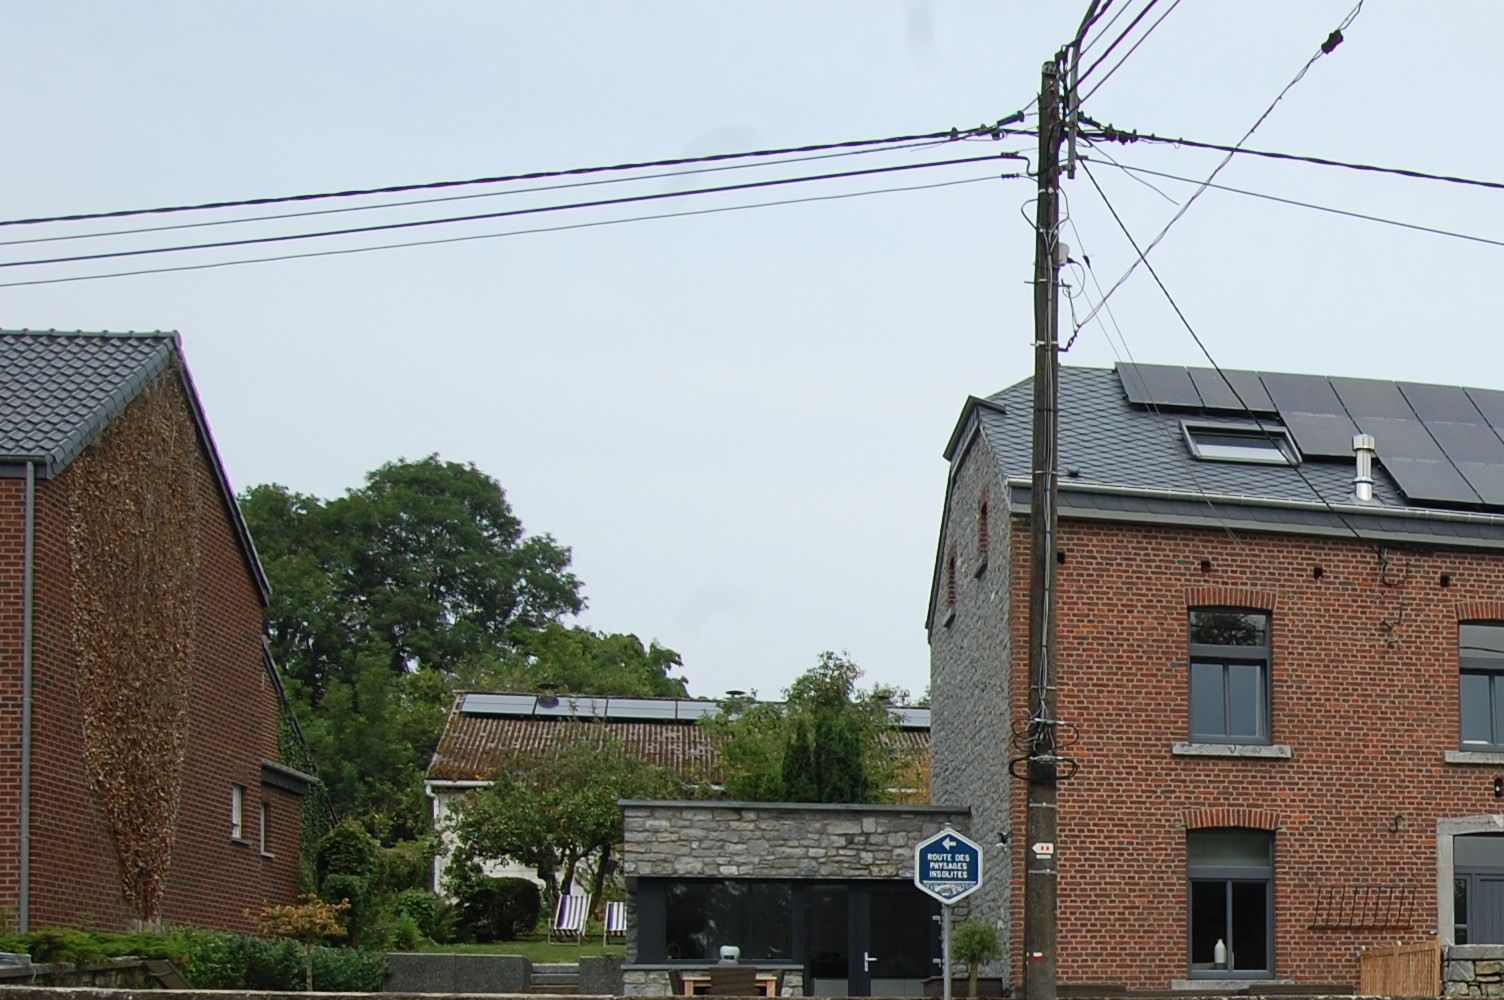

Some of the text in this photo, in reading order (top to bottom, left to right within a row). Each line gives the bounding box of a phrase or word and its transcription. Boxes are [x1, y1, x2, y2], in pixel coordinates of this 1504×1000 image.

[927, 853, 970, 862] ROUTE DES
[929, 862, 968, 870] PAYSAGES
[929, 870, 968, 878] INSOLITES
